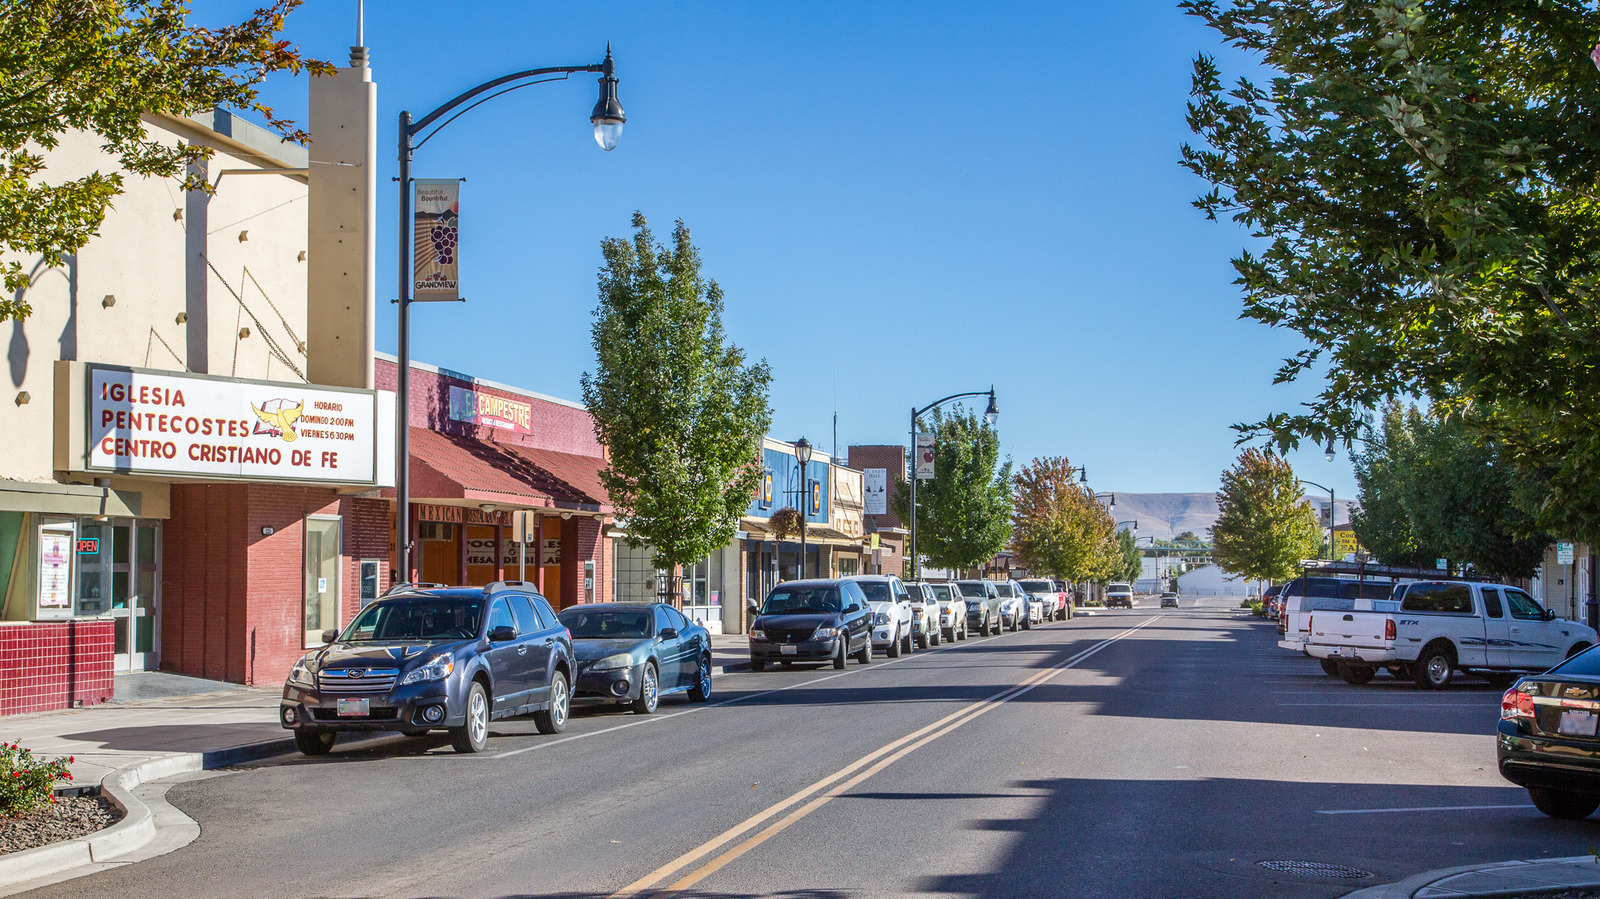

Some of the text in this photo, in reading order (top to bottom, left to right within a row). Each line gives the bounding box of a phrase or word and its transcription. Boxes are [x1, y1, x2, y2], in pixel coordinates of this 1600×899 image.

[415, 281, 456, 290] GRANDVIEW
[102, 382, 186, 407] IGLESIA
[314, 400, 343, 412] HORARIO
[478, 394, 530, 431] CAMPESTRE
[102, 409, 250, 438] PENTECOSTES
[300, 414, 328, 424] DOMINGO
[300, 428, 329, 438] VIERNES
[101, 438, 338, 468] CENTRO CRISTIANO DE FE
[420, 504, 461, 522] MEXICAN
[76, 540, 98, 552] OPEN
